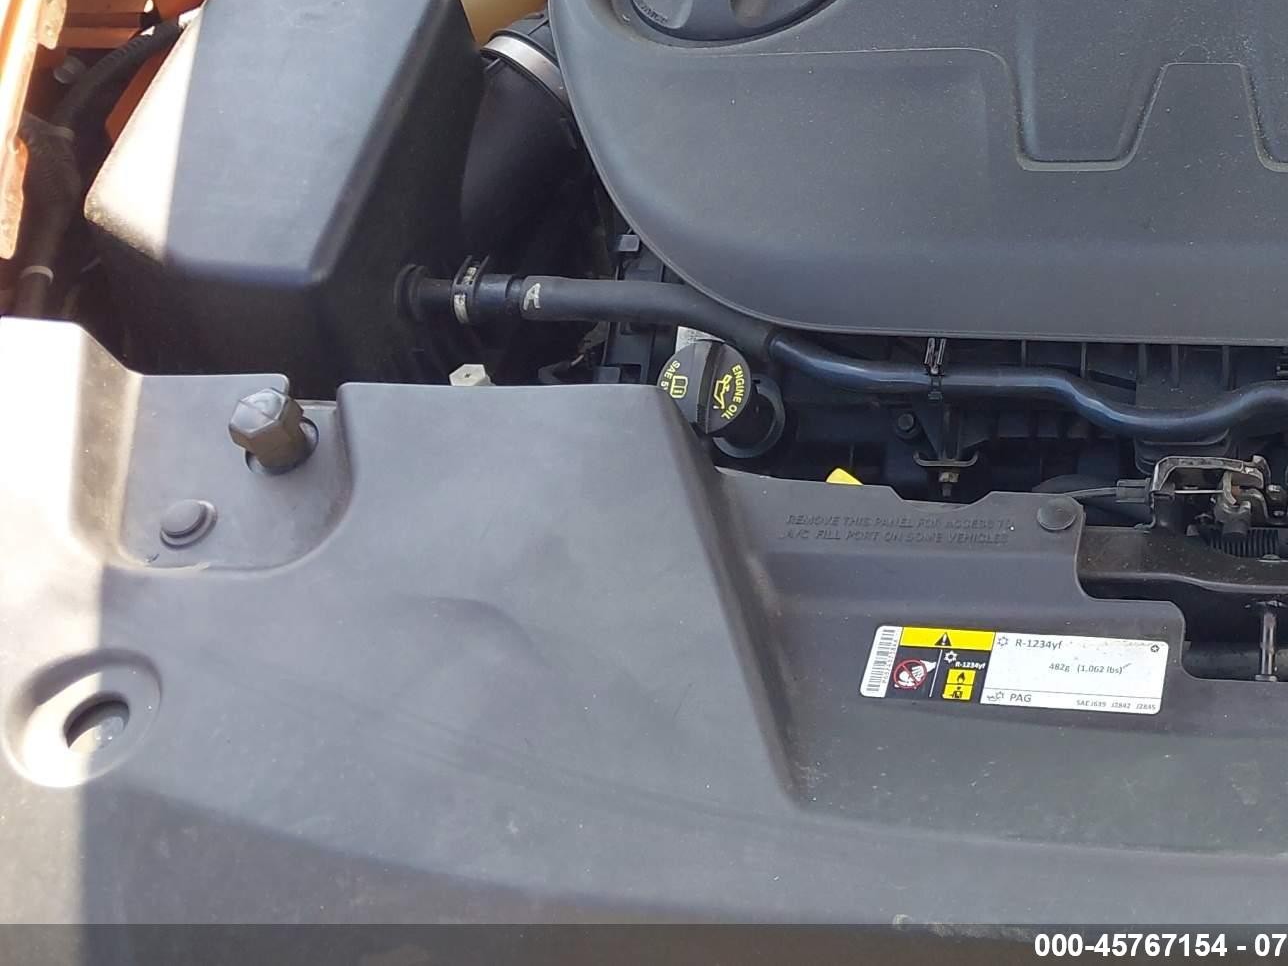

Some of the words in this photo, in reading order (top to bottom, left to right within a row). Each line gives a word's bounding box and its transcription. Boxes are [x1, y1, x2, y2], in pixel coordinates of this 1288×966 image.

[664, 360, 680, 381] SAE
[731, 364, 745, 404] ENGINE
[720, 404, 738, 420] OIL
[815, 529, 841, 540] FILL
[1014, 638, 1062, 651] R-1234yf
[1048, 662, 1070, 674] 482g
[1009, 692, 1032, 703] PAG
